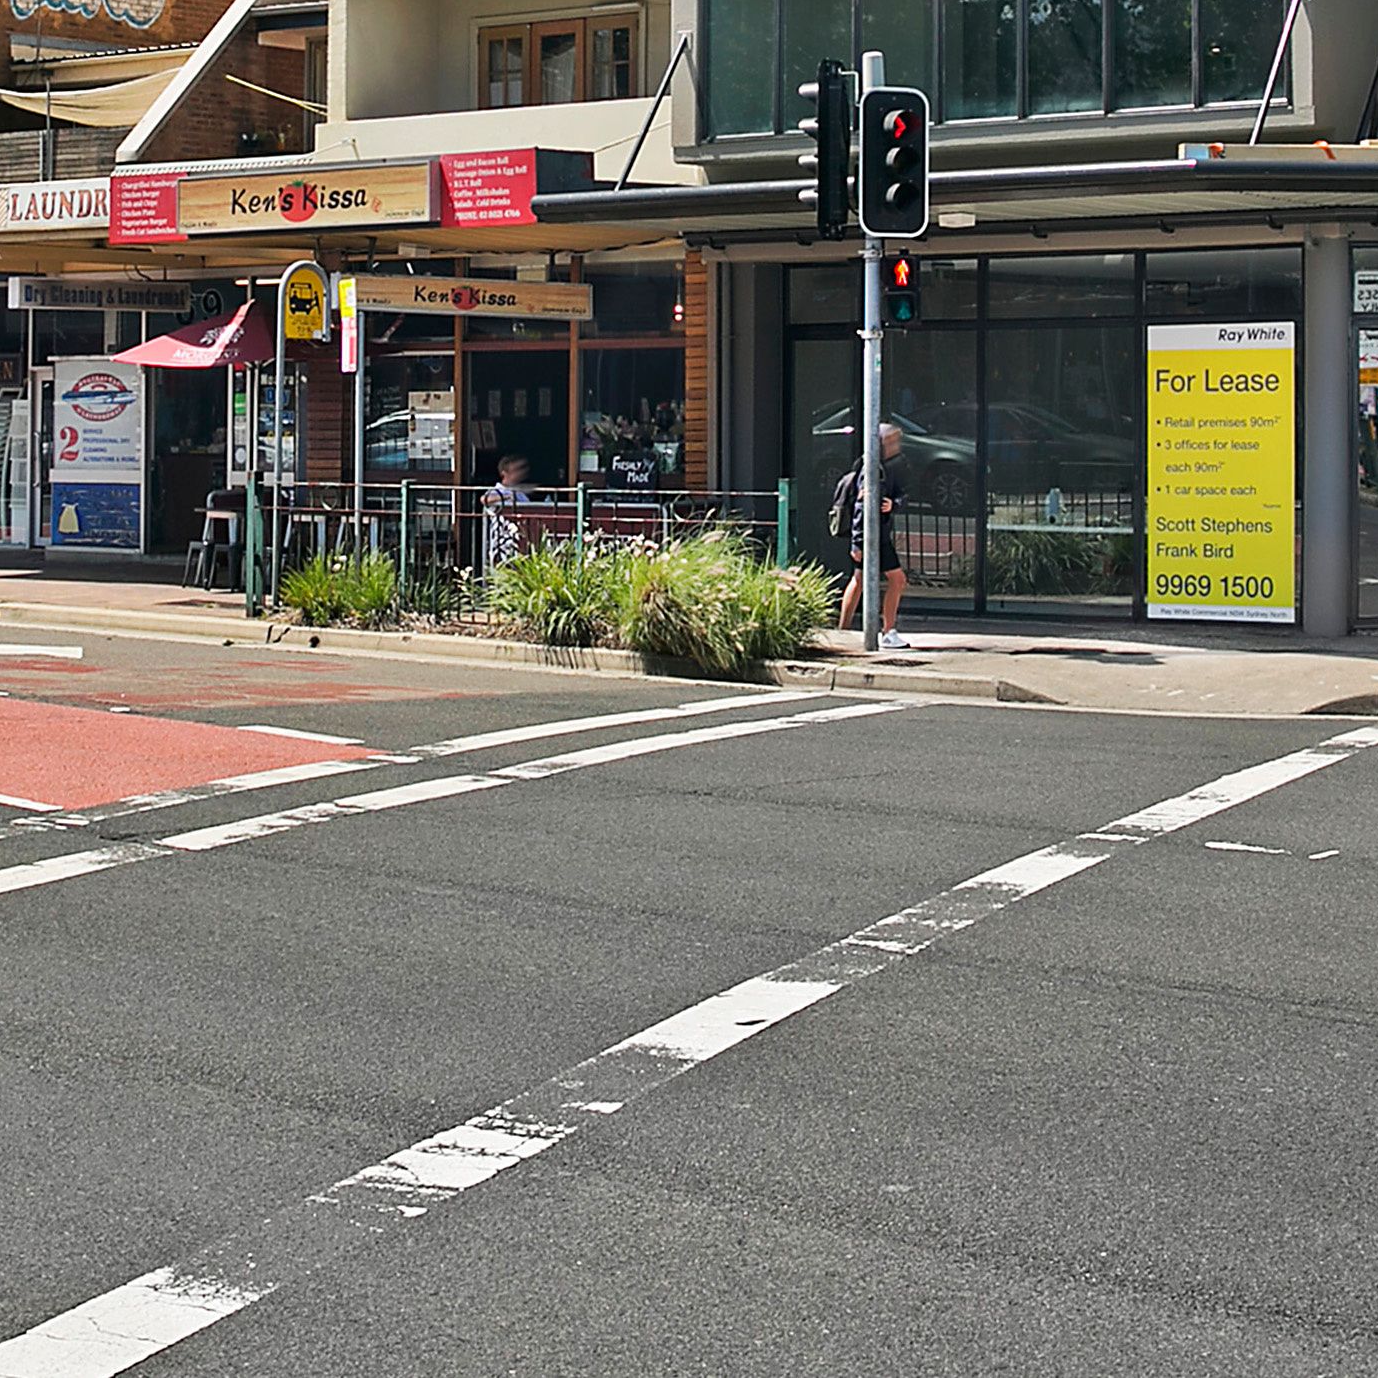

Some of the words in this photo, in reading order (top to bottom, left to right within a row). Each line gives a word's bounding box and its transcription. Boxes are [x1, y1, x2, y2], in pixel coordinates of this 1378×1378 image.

[231, 187, 295, 215] Ken's
[302, 183, 369, 211] Kissa
[24, 285, 47, 305] Dry
[50, 286, 103, 307] Cleaning
[106, 289, 114, 304] &
[118, 287, 186, 305] Laundromat
[414, 286, 462, 304] Ken's
[469, 286, 517, 306] Kissa
[1218, 329, 1245, 343] Ray
[1247, 328, 1285, 341] White
[1155, 369, 1196, 393] For
[1204, 369, 1280, 393] Lease
[1164, 417, 1194, 427] Retail
[1198, 417, 1247, 429] premises
[60, 426, 79, 461] 2
[1164, 440, 1172, 450] 3
[1174, 440, 1210, 450] offices
[1213, 440, 1228, 450] for
[1231, 440, 1260, 450] lease
[1165, 463, 1192, 472] each
[627, 471, 649, 483] MADE
[1165, 485, 1170, 494] 1
[1174, 486, 1192, 495] car
[1195, 486, 1228, 496] space
[1230, 485, 1257, 495] each
[1156, 516, 1196, 532] Scott
[1201, 517, 1273, 535] Stephens
[1156, 543, 1198, 557] Frank
[1203, 543, 1234, 559] Bird
[1156, 574, 1211, 597] 9969
[1220, 576, 1274, 599] 1500
